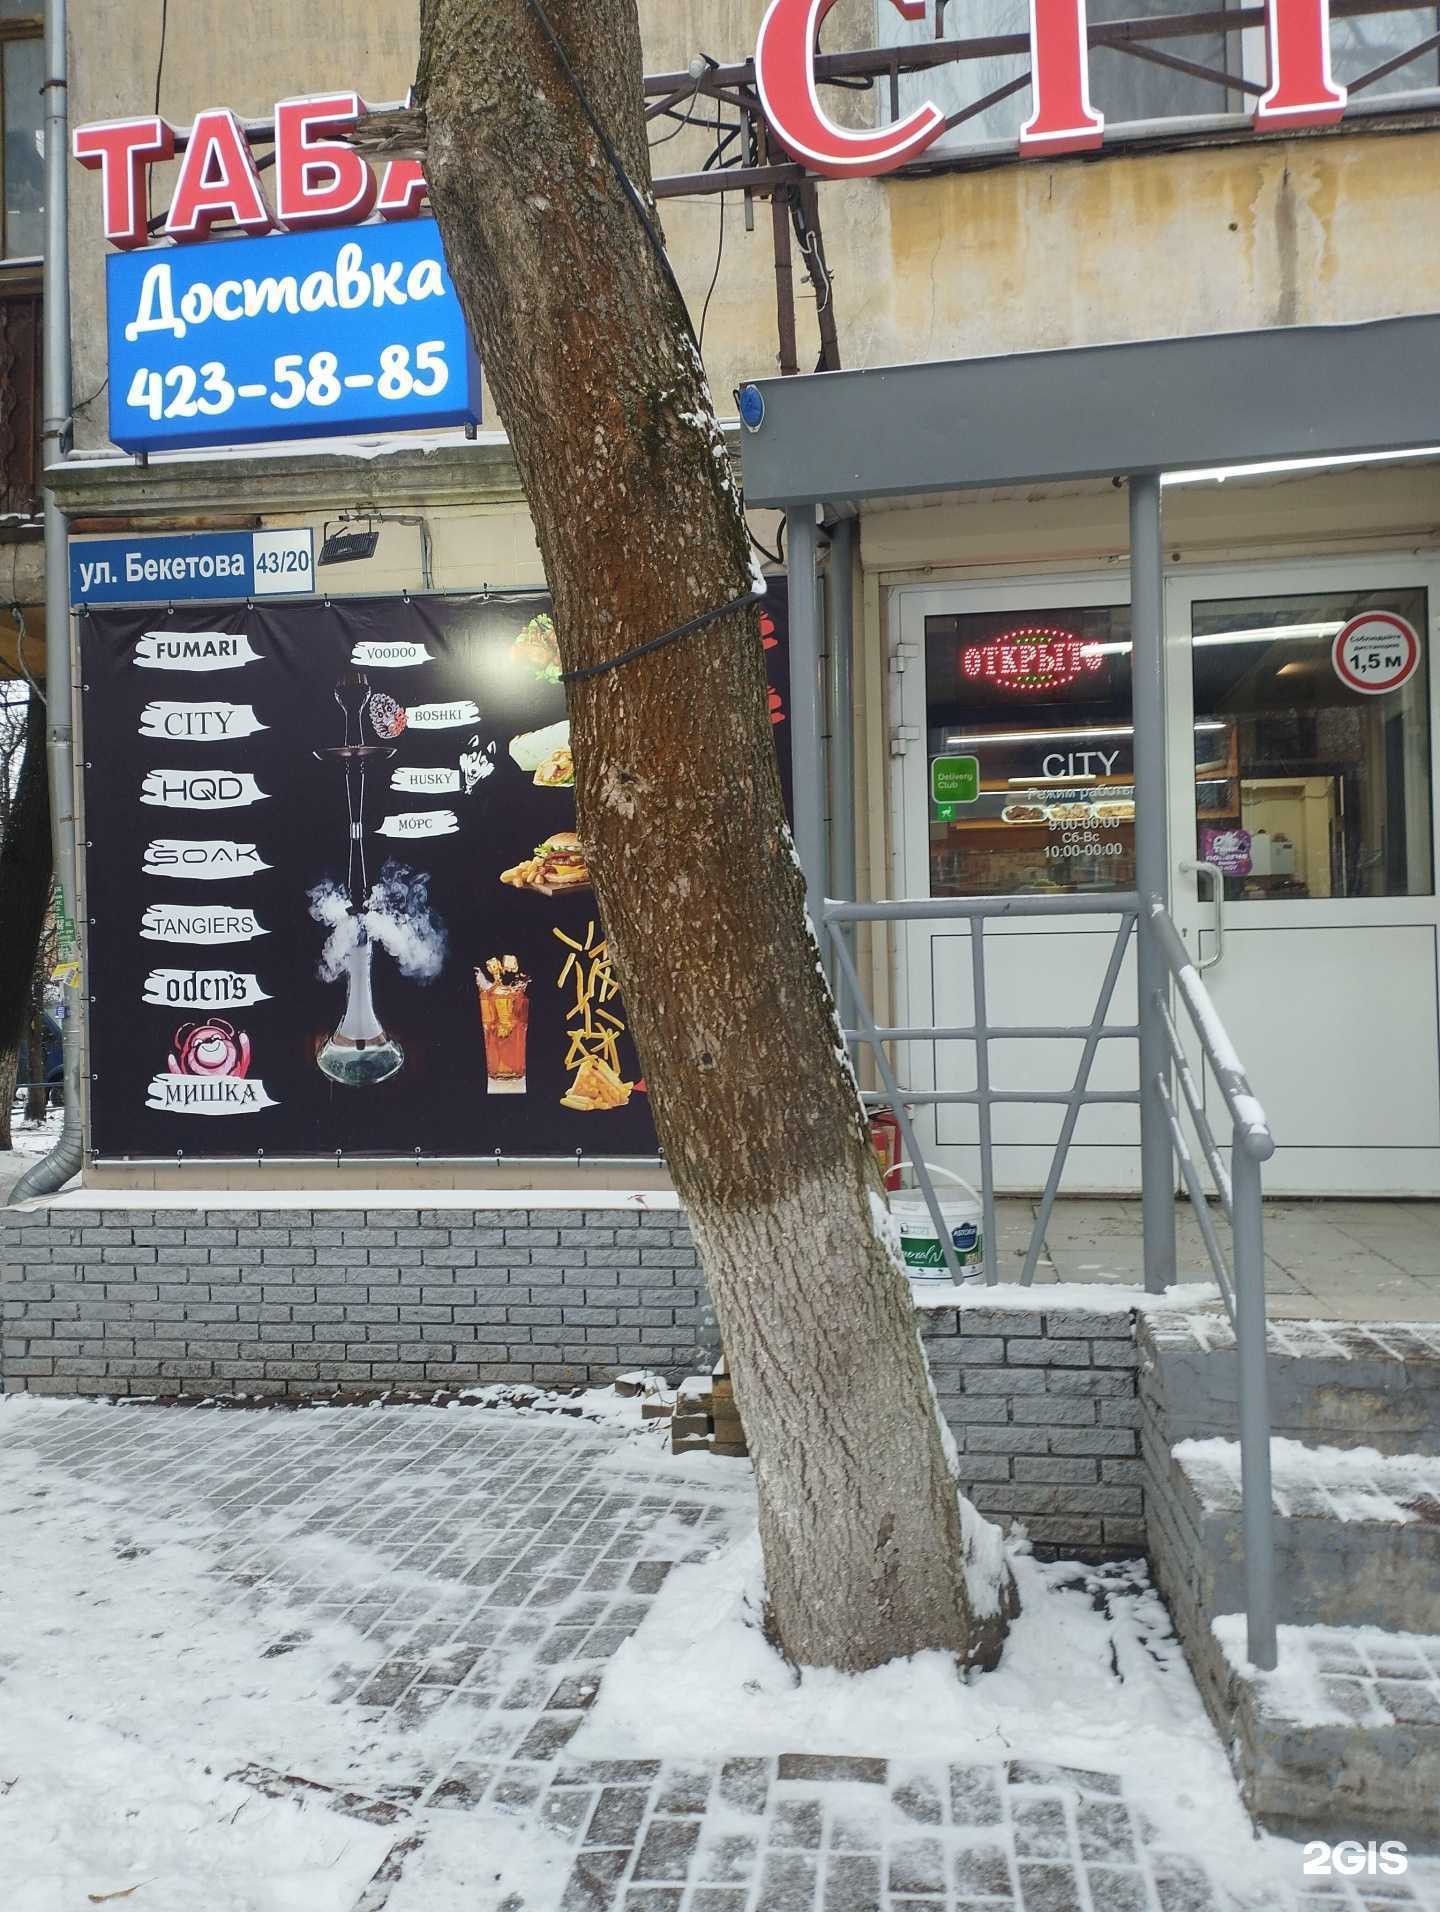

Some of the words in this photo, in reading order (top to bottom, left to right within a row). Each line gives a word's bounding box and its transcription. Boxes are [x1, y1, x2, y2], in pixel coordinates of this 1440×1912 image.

[125, 243, 446, 341] Доставка
[126, 340, 449, 421] 423-58-85
[80, 559, 118, 592] ул.
[125, 549, 246, 583] Бекетова
[256, 547, 310, 576] 43/20
[156, 638, 238, 659] FUMARI
[367, 646, 416, 659] VOODOO
[1350, 653, 1380, 673] 1,5
[164, 709, 235, 737] CITY
[415, 709, 463, 722] BOSHKI
[1042, 750, 1120, 778] CITY
[410, 772, 454, 785] HUSKY
[937, 772, 973, 781] Delivery
[937, 780, 959, 789] Club
[162, 777, 243, 802] HQD
[1027, 787, 1076, 800] Режим
[1061, 831, 1101, 843] Сб-Вс
[153, 846, 259, 865] SOAK
[1043, 842, 1123, 858] 10:00-00:00
[154, 915, 254, 936] TANGIERS
[166, 973, 247, 1003] oden's
[165, 1080, 258, 1107] МИШКА
